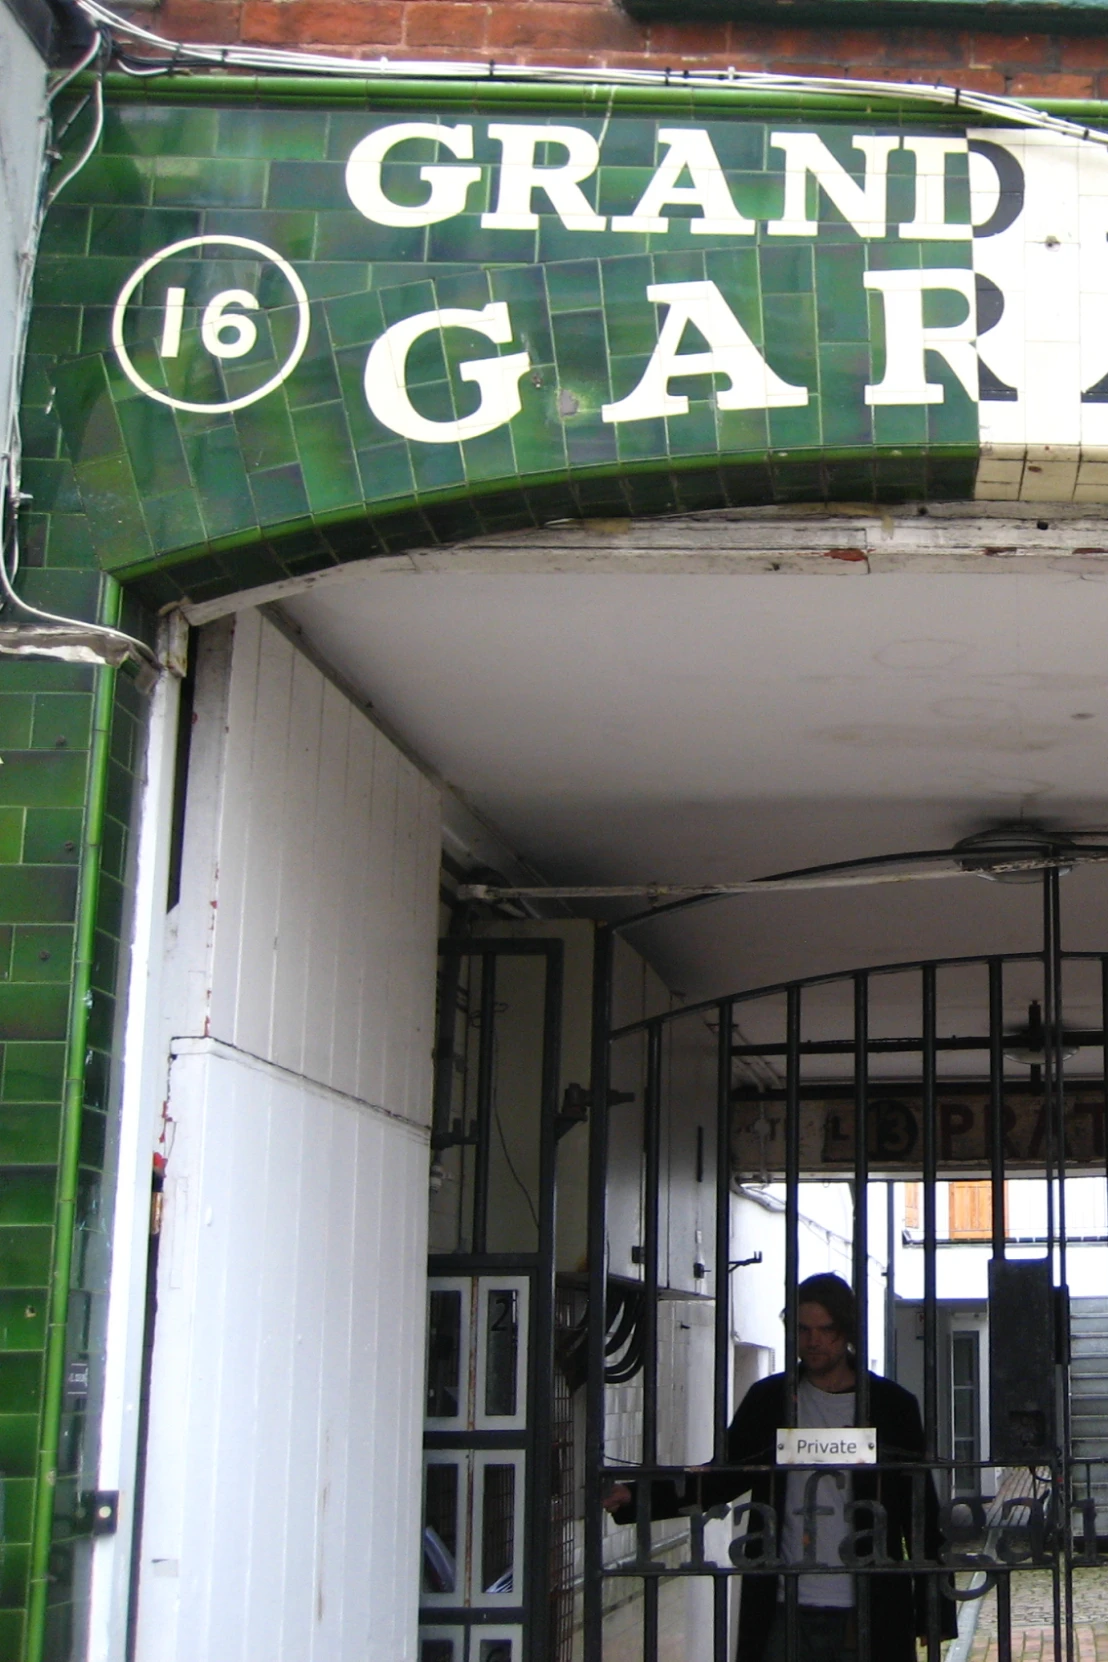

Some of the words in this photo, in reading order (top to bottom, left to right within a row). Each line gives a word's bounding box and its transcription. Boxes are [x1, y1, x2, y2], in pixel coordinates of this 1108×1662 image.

[345, 121, 1025, 241] GRAND
[158, 287, 259, 360] 16
[491, 1298, 509, 1331] 2
[796, 1438, 858, 1455] Private
